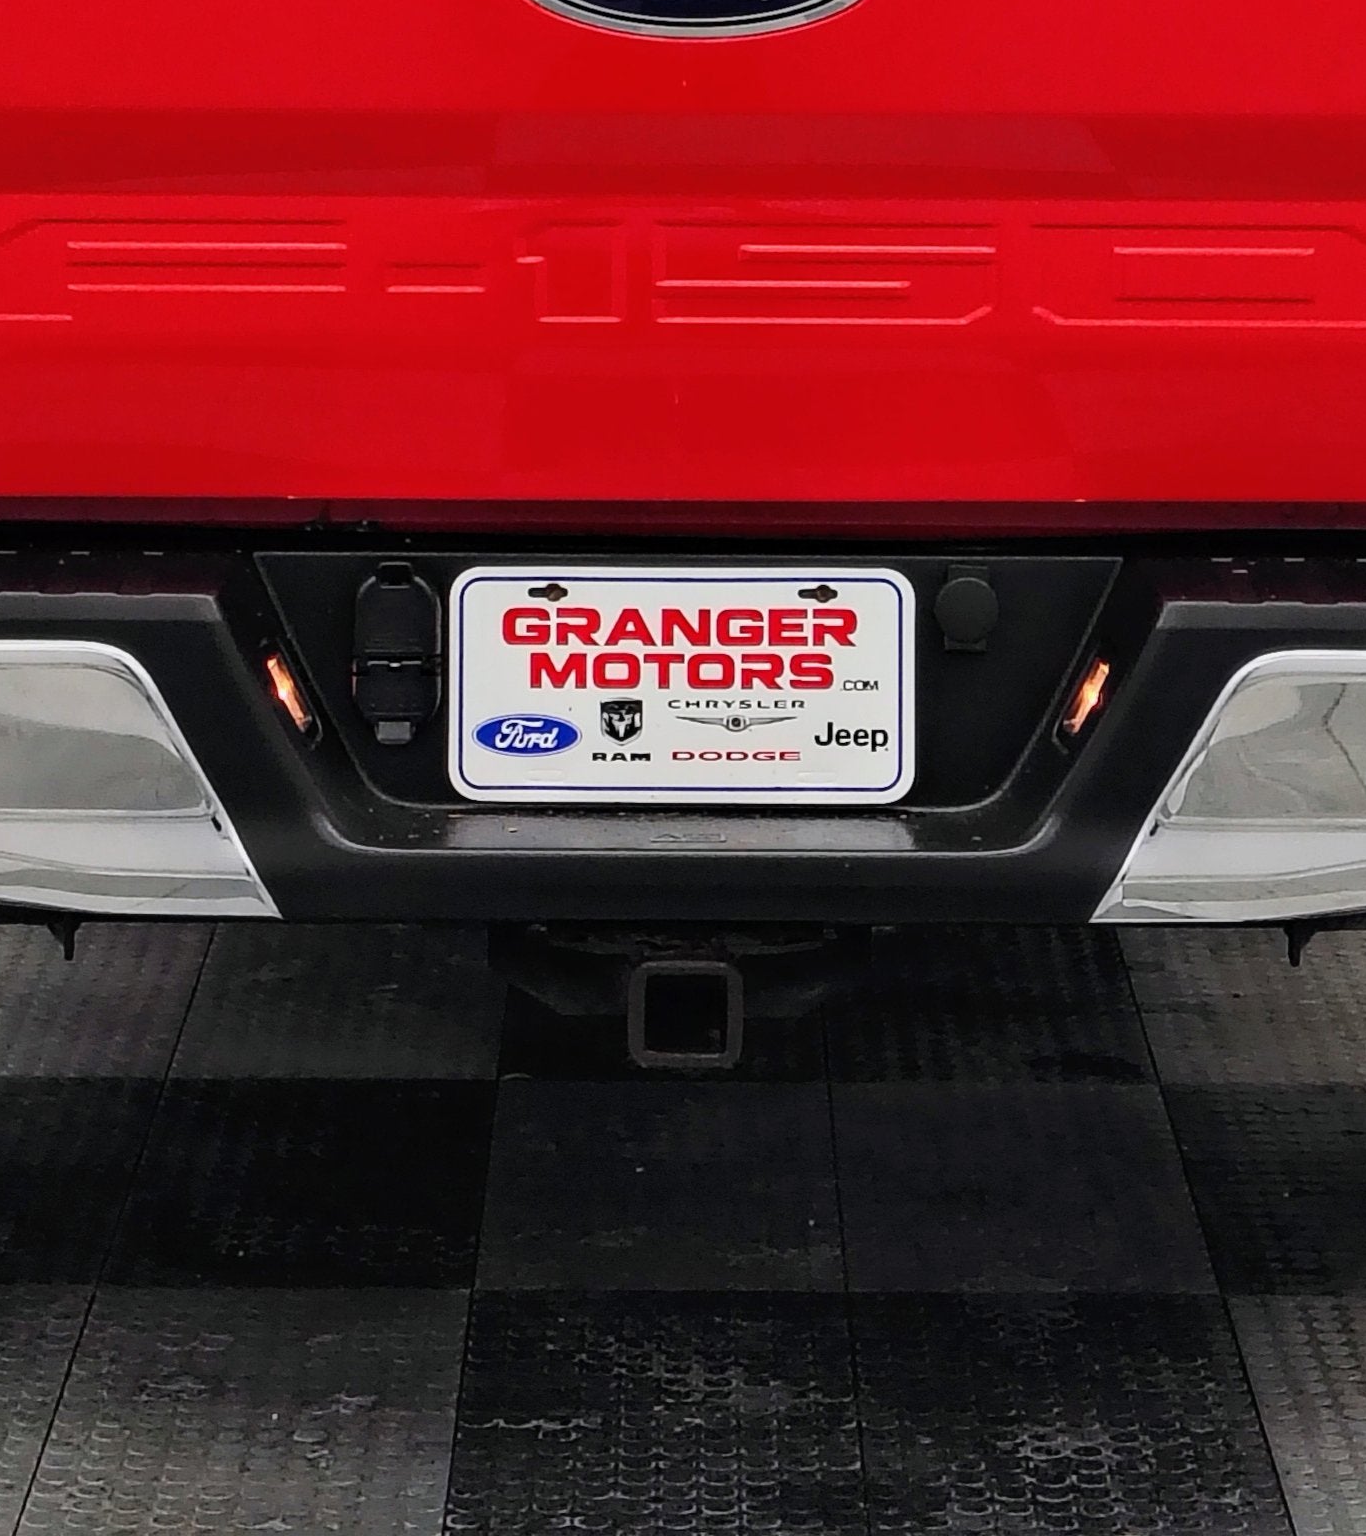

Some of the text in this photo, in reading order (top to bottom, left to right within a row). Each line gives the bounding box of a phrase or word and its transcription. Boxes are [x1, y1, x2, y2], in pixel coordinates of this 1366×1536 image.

[502, 607, 857, 647] GRANGER
[529, 652, 834, 690] MOTORS
[667, 699, 806, 710] CHRYSLER
[494, 720, 558, 750] Ford
[814, 722, 889, 752] Jeep
[591, 752, 651, 763] RAM
[672, 751, 801, 762] DODGE
